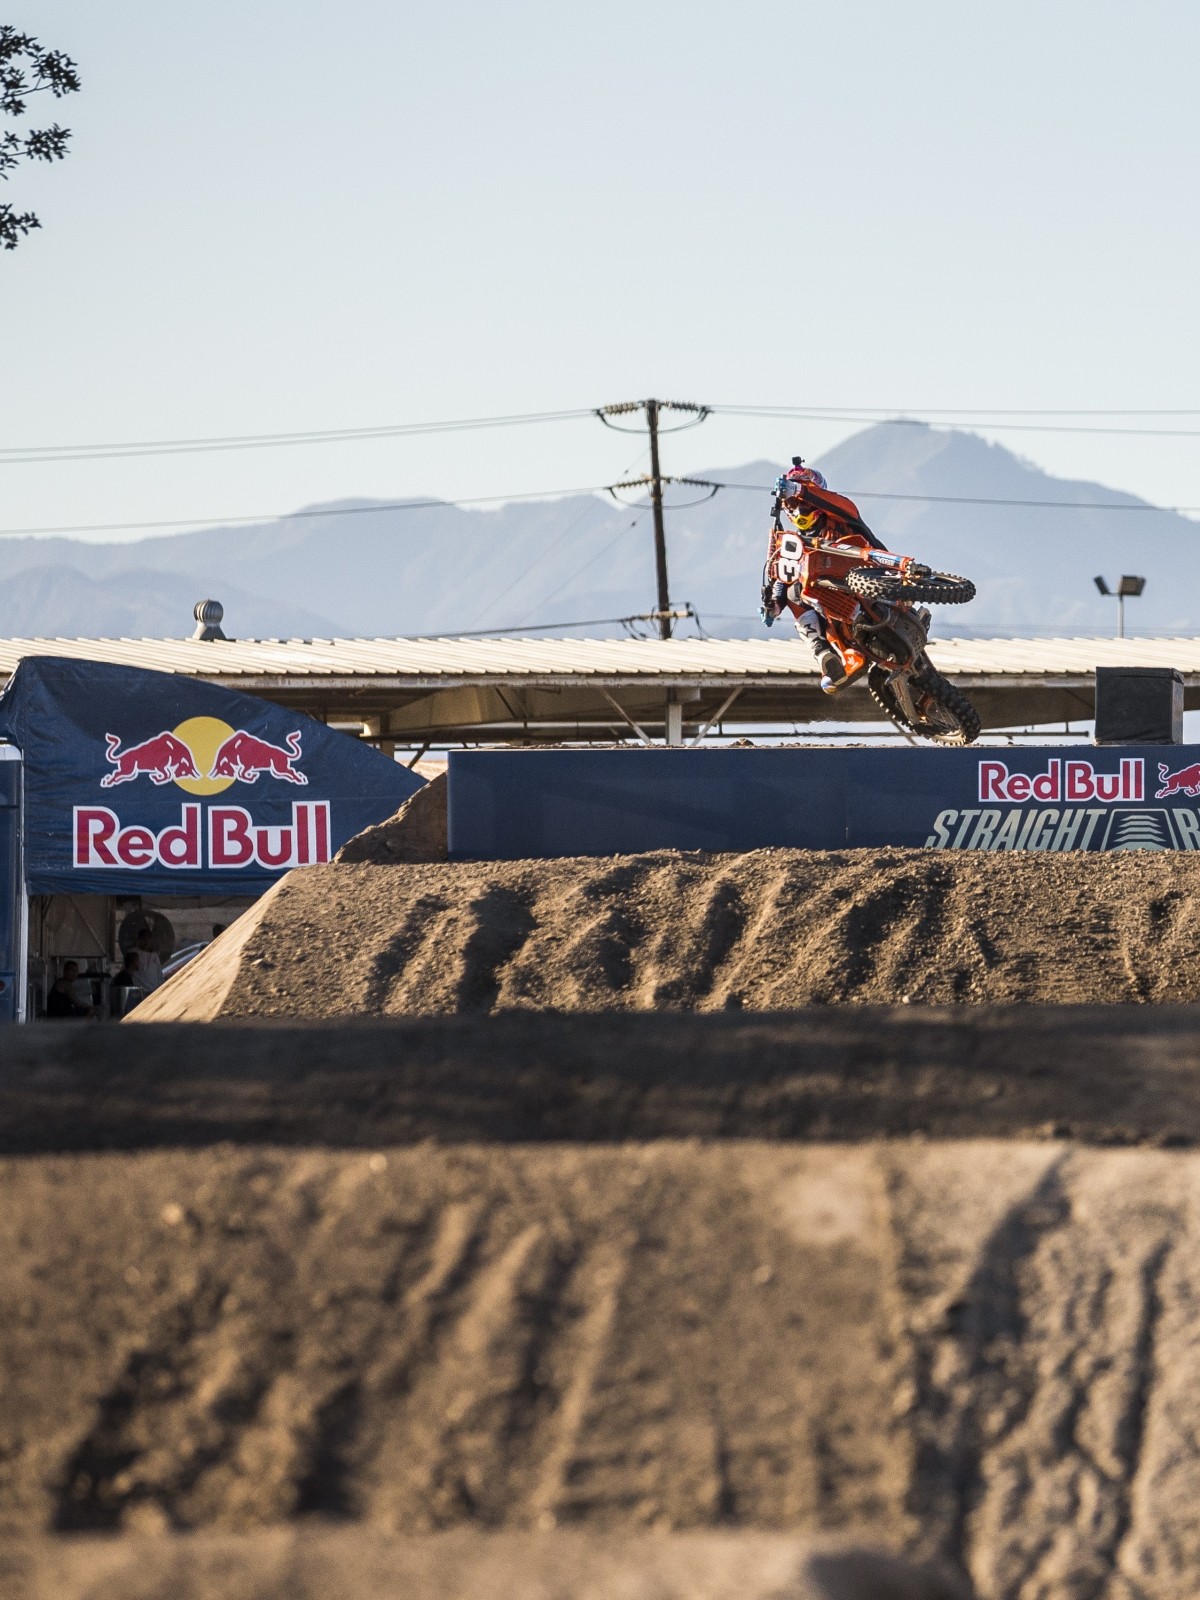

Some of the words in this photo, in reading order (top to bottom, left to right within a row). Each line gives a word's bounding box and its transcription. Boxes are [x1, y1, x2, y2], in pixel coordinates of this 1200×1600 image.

[778, 533, 803, 583] 30
[979, 759, 1061, 802] Red
[1065, 758, 1145, 802] Bull
[74, 803, 201, 868] Red
[208, 801, 331, 868] Bull
[925, 808, 1107, 850] STRAIGHT
